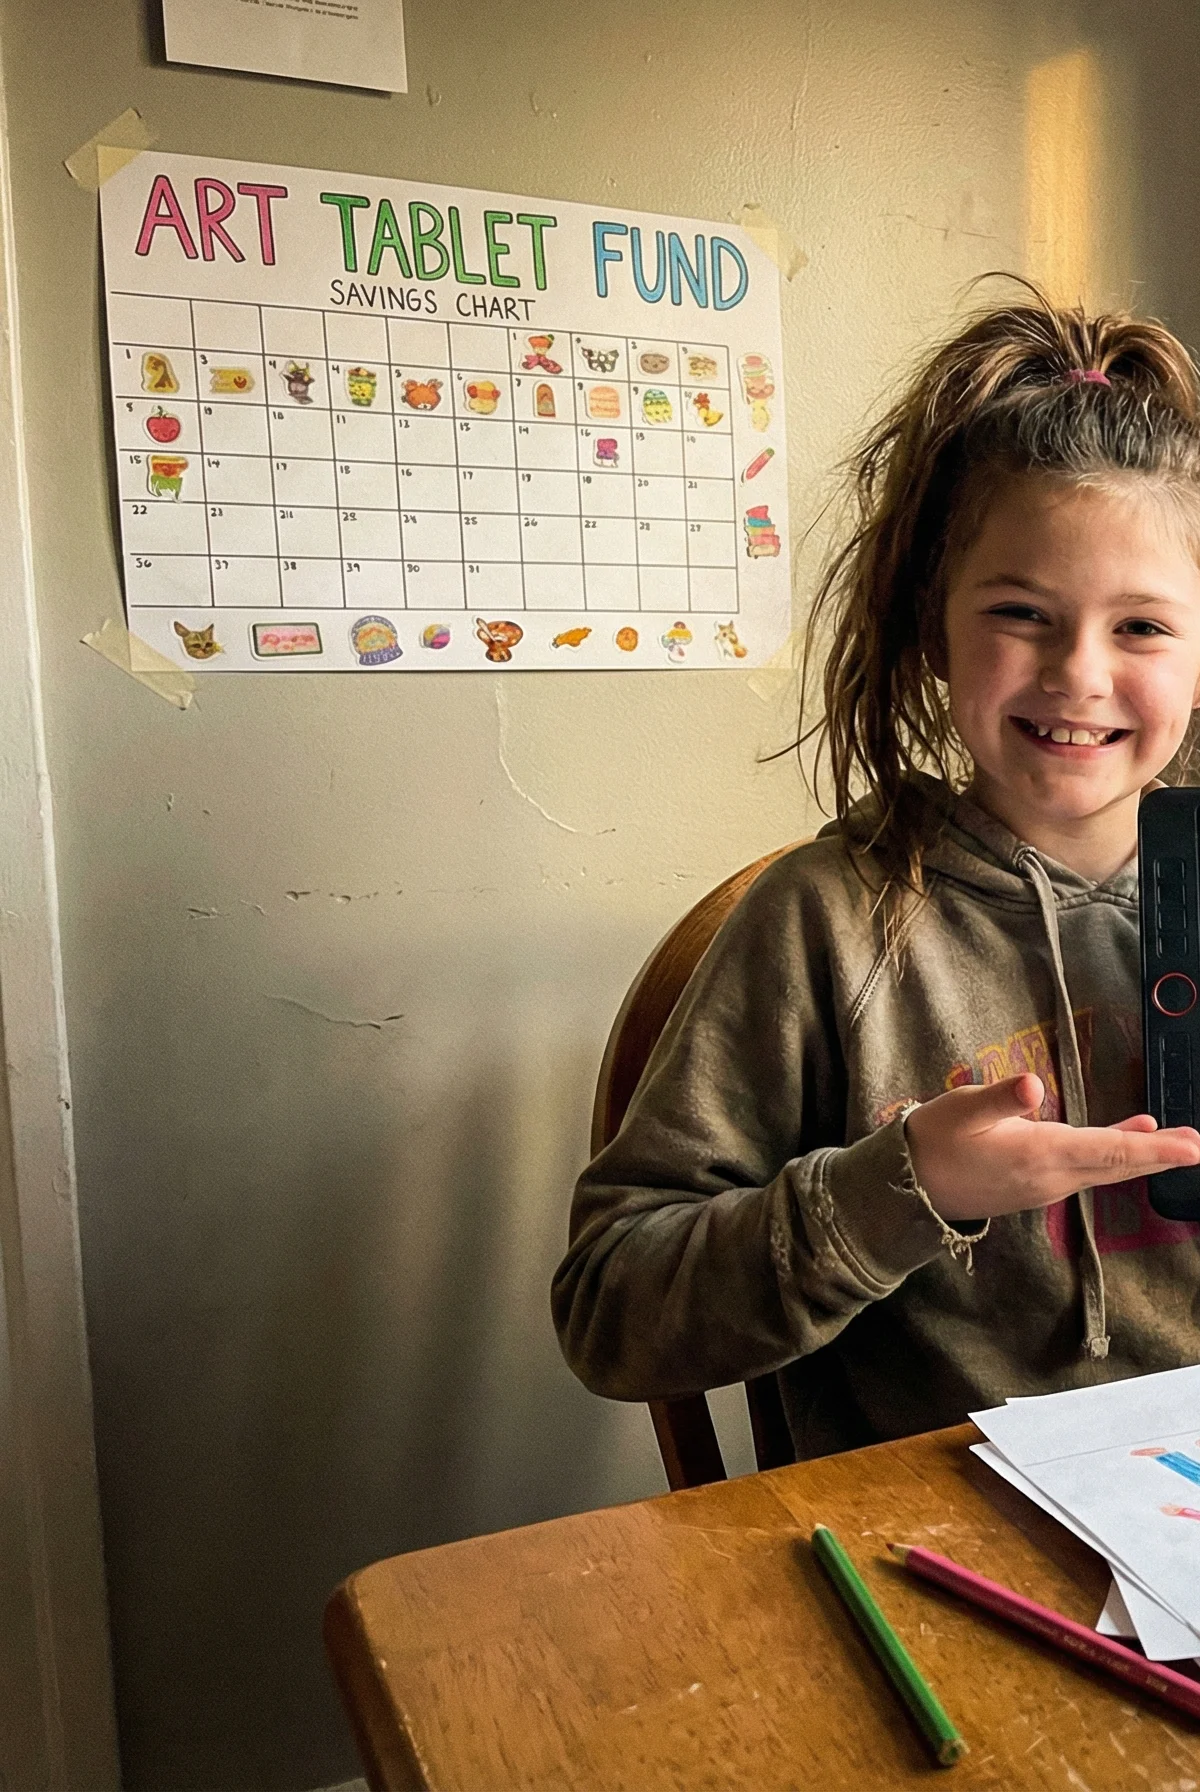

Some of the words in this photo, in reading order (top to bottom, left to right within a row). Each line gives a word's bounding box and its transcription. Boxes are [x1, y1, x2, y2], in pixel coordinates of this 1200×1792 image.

[135, 175, 288, 266] ART
[320, 192, 558, 292] TABLET
[592, 220, 749, 311] FUND
[329, 278, 438, 314] SAVINGS
[455, 292, 536, 322] CHART
[336, 414, 347, 425] 11
[518, 425, 530, 435] 14
[580, 428, 592, 438] 16
[400, 468, 413, 477] 16
[462, 470, 474, 481] 17
[637, 478, 650, 488] 20
[131, 504, 148, 515] 22
[214, 559, 229, 571] 37
[283, 560, 297, 572] 38
[346, 562, 361, 573] 39
